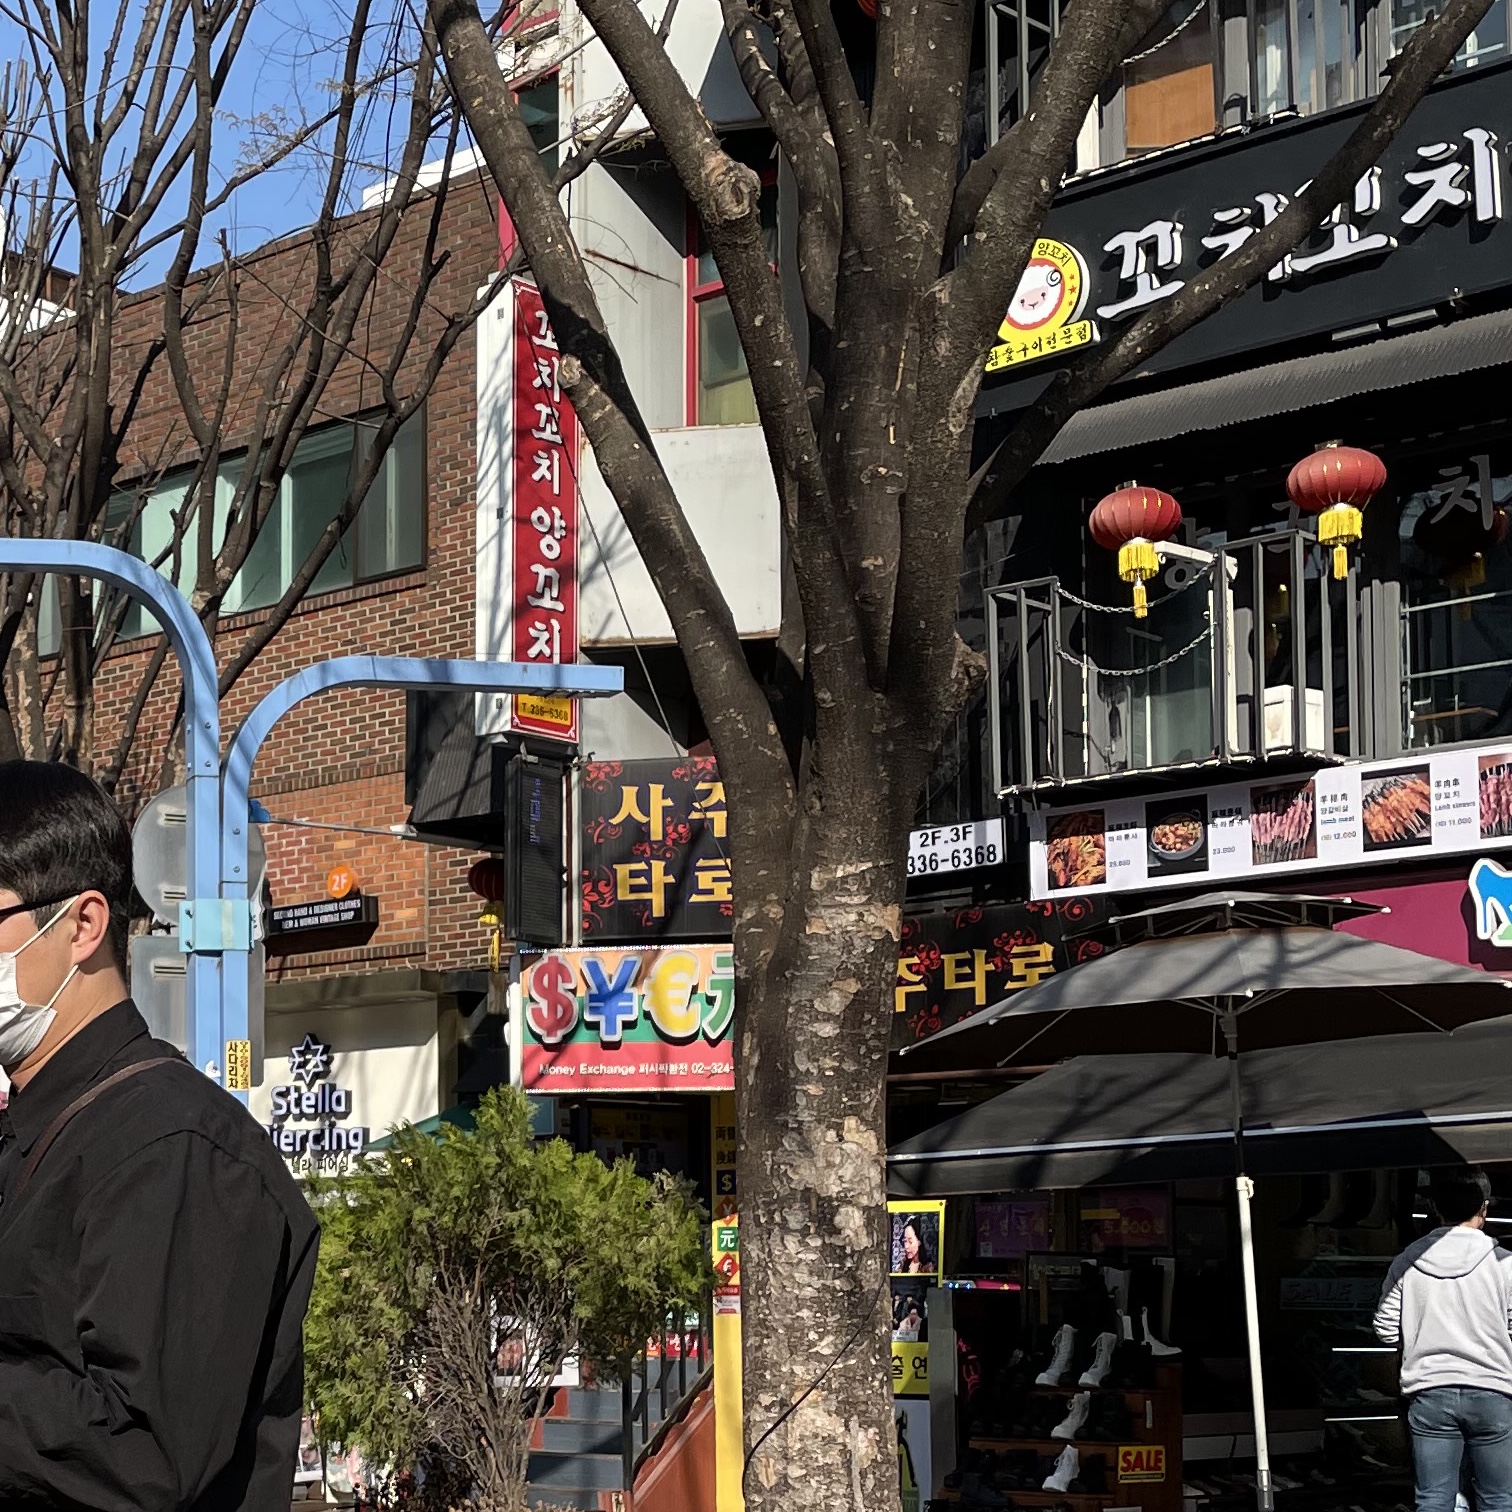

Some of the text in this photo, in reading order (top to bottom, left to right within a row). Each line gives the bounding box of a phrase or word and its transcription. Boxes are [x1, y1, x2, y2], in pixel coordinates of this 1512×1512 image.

[1038, 242, 1072, 267] 양꼬치
[908, 844, 997, 874] 336-6368
[331, 874, 347, 891] 2F
[228, 1041, 238, 1089] 사다리차
[540, 1063, 575, 1076] Money
[579, 1063, 636, 1075] Exchange
[272, 1084, 346, 1115] Stella
[265, 1121, 363, 1155] iercing
[720, 1230, 735, 1248] 元
[1120, 1450, 1164, 1473] SALE
